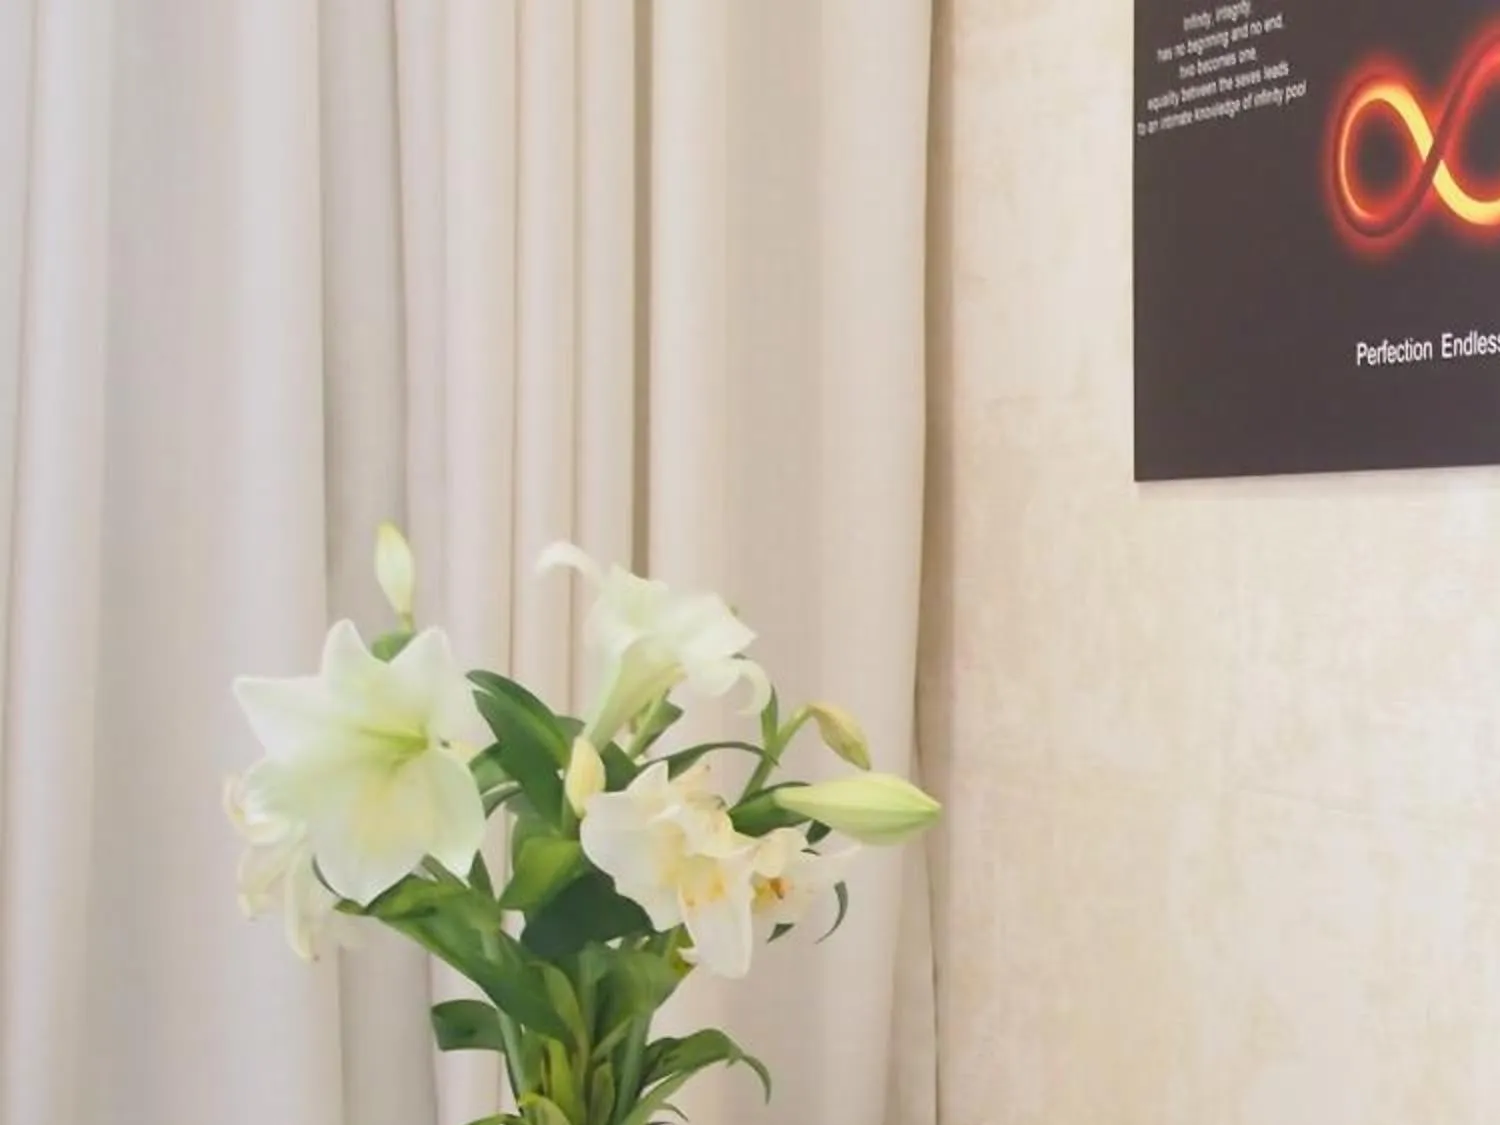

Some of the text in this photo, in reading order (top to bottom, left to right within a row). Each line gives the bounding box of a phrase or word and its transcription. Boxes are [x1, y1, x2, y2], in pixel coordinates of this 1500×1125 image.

[1231, 24, 1248, 41] and
[1250, 21, 1262, 35] no
[1197, 52, 1236, 75] becomes
[1181, 82, 1217, 102] between
[1218, 77, 1233, 92] the
[1242, 93, 1252, 110] of
[1356, 338, 1433, 366] Perfection
